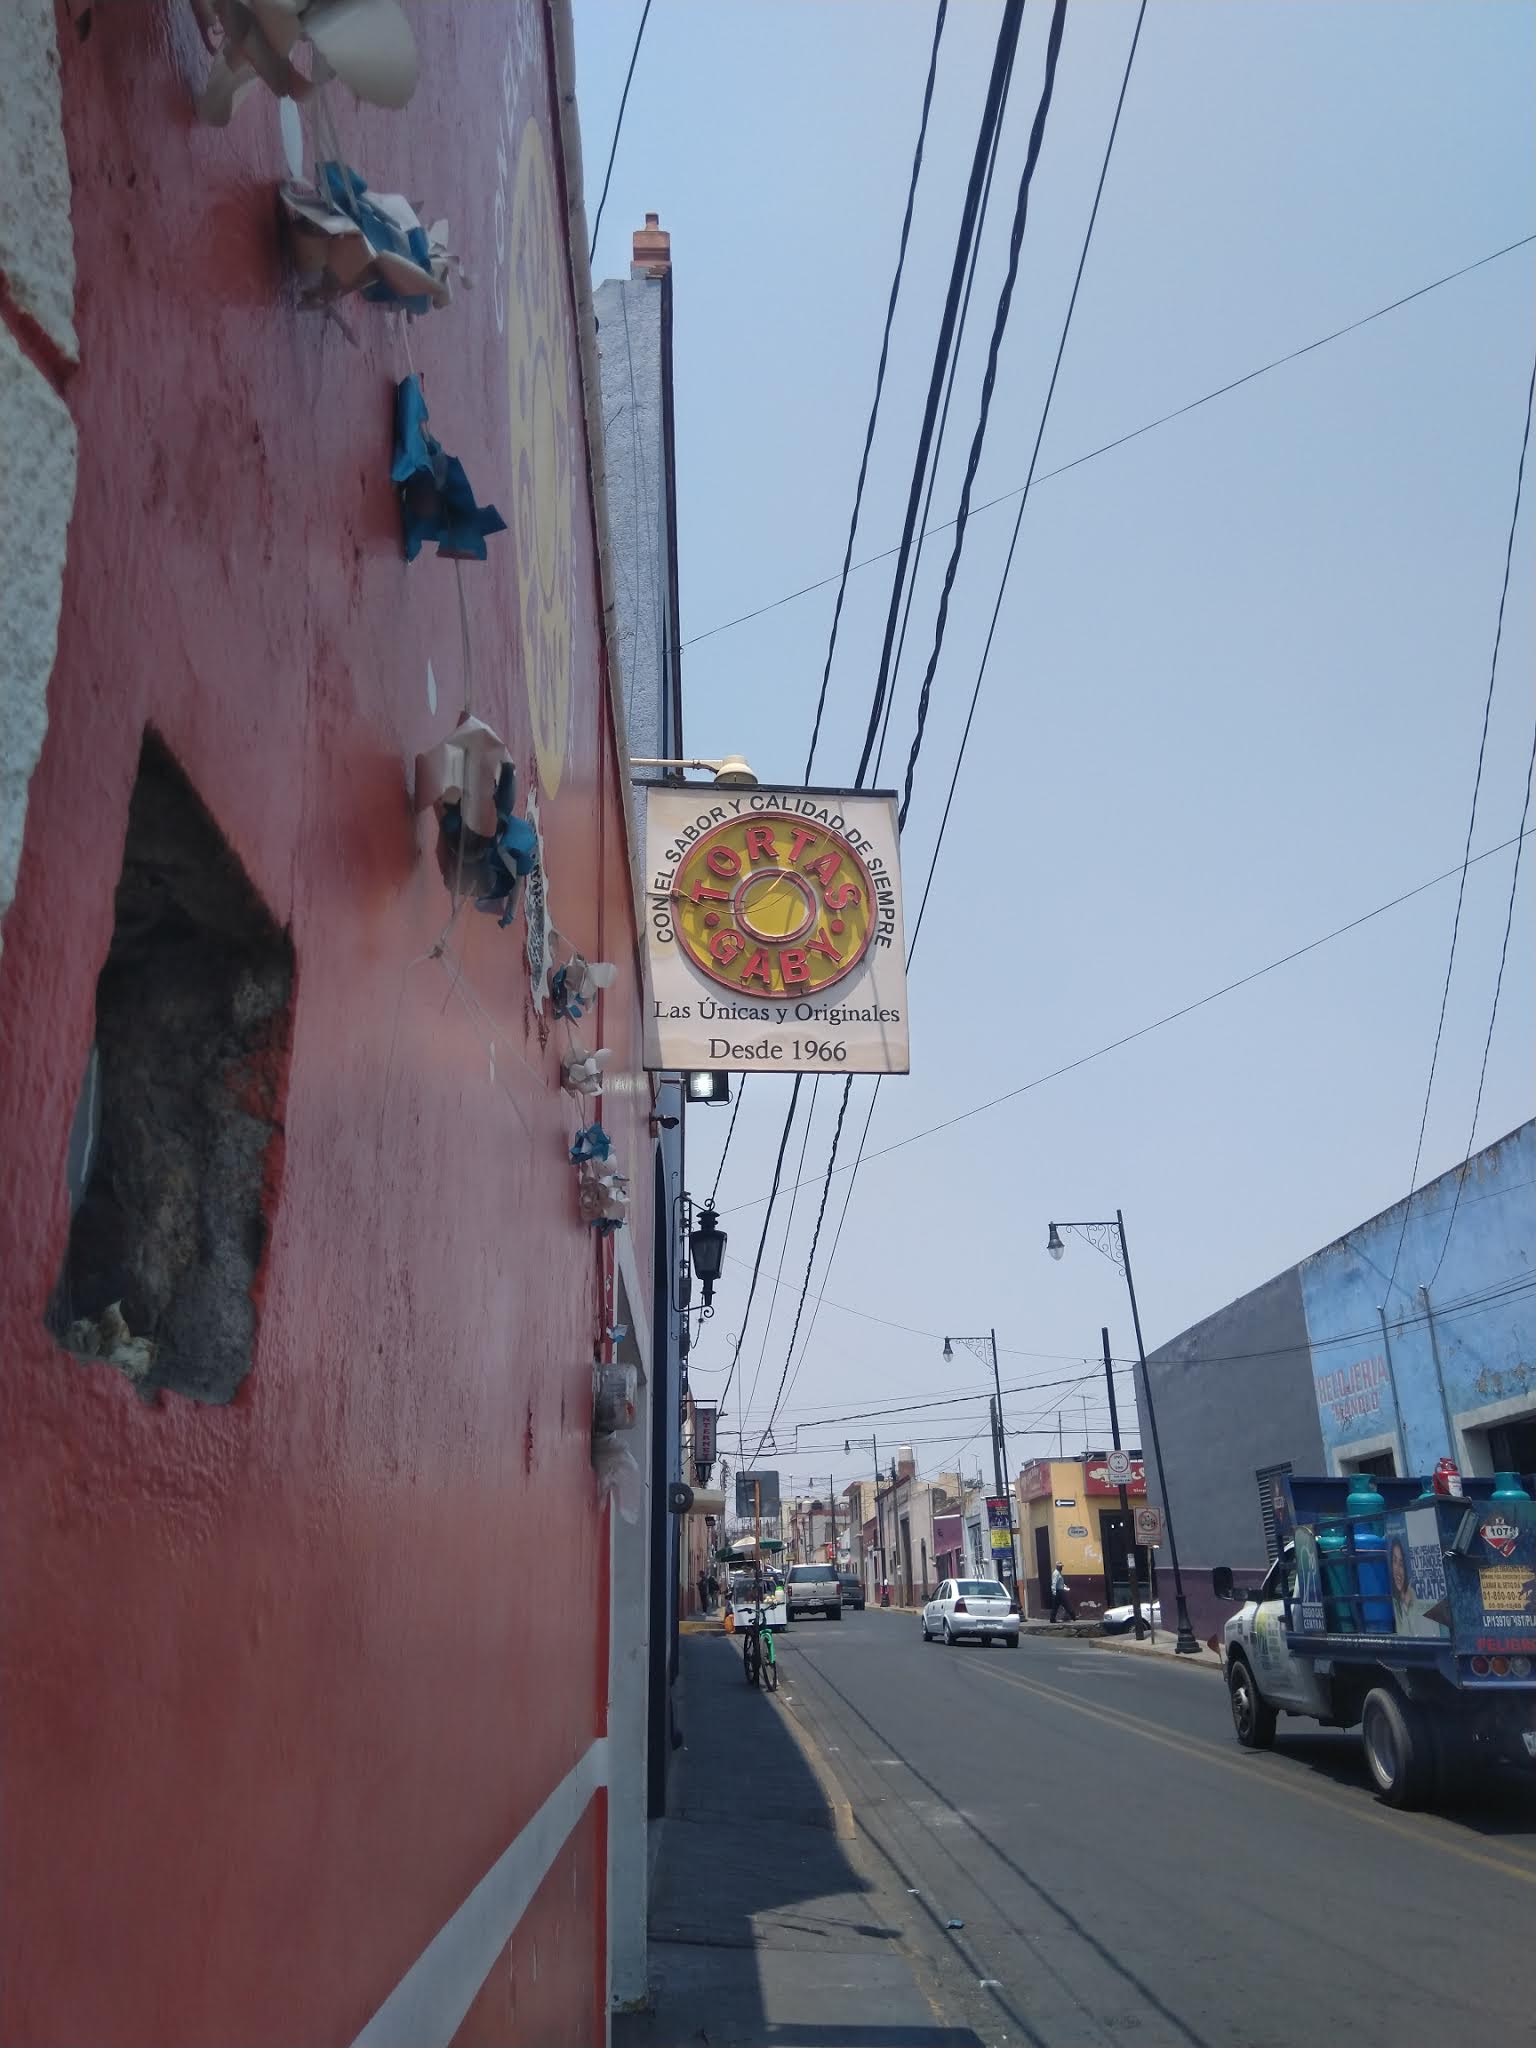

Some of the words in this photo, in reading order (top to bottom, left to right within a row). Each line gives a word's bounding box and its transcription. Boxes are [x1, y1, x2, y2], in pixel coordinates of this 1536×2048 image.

[728, 798, 742, 814] Y
[749, 794, 845, 831] CALIDAD
[665, 806, 728, 863] SABOR
[843, 827, 873, 856] DE
[654, 867, 675, 893] EL
[691, 826, 862, 910] TORTAS
[653, 894, 675, 944] CON
[866, 856, 896, 949] SIEMPRE
[709, 927, 843, 985] GABY
[652, 1000, 691, 1020] Las
[697, 996, 770, 1021] Únicas
[775, 1006, 788, 1024] y
[794, 1002, 901, 1025] Originales
[708, 1038, 784, 1061] Desde
[793, 1040, 847, 1062] 1966
[703, 1410, 711, 1461] INTERNET
